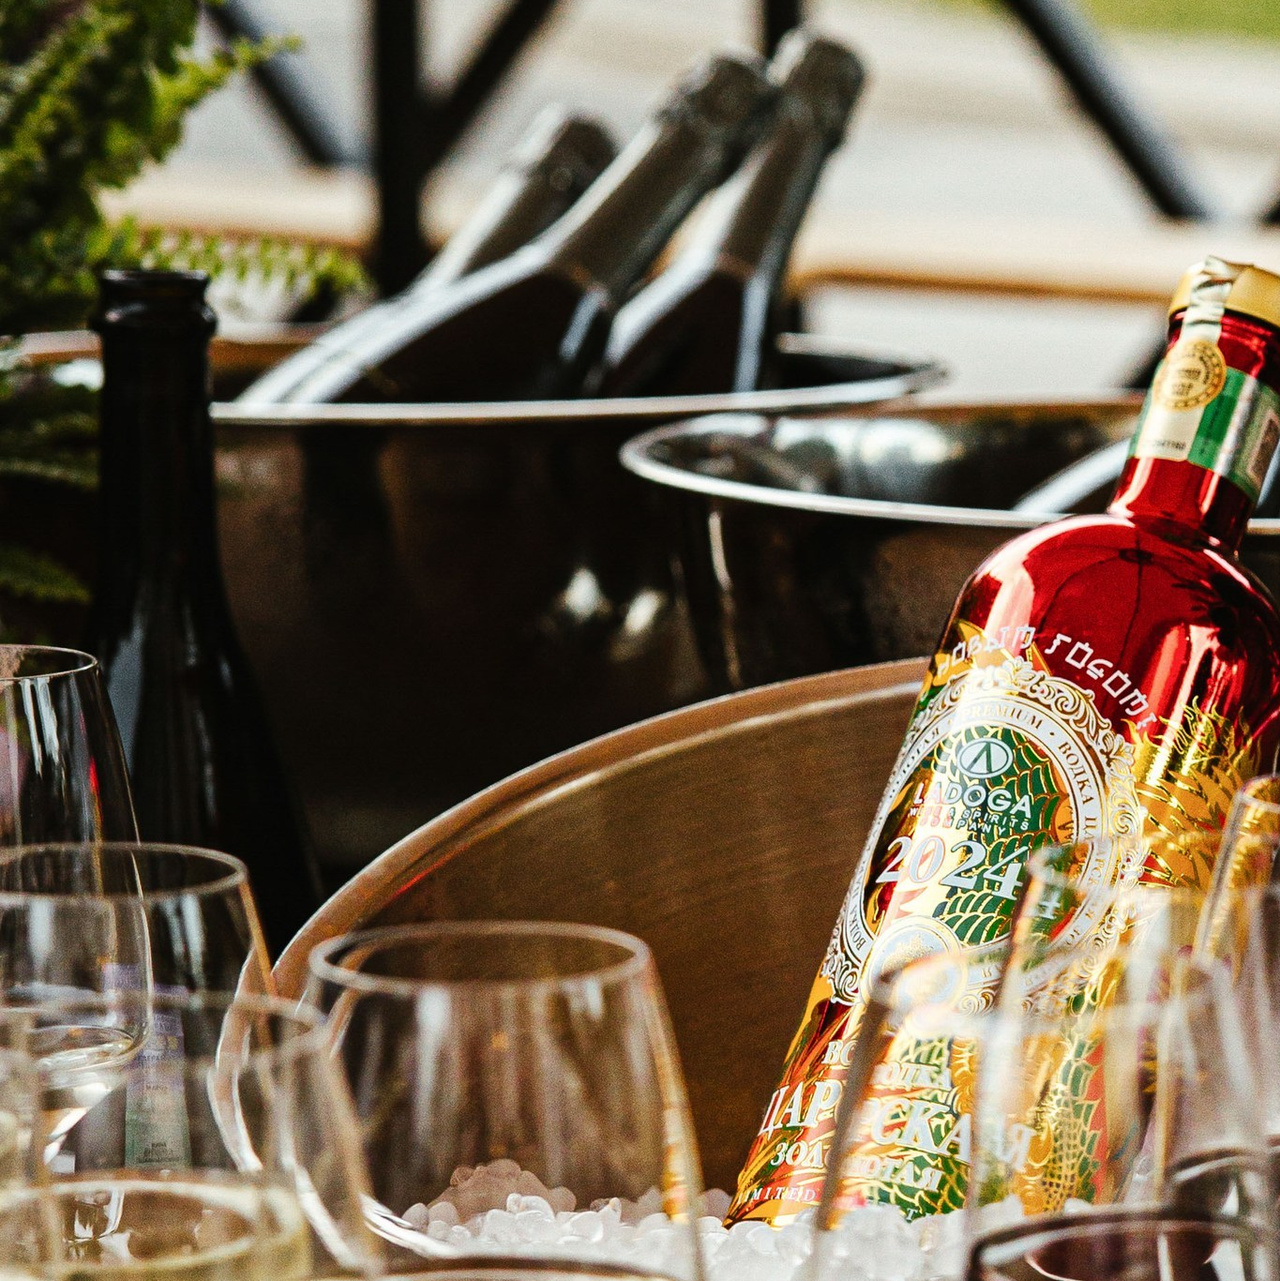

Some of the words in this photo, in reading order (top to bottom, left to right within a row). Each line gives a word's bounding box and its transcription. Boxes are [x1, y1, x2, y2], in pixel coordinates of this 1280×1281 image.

[957, 703, 1043, 730] PREMIUM
[1058, 741, 1095, 805] ВОДКА
[913, 779, 1032, 819] LADOGA
[961, 808, 1030, 831] SPIRITS
[876, 835, 1029, 901] 2024
